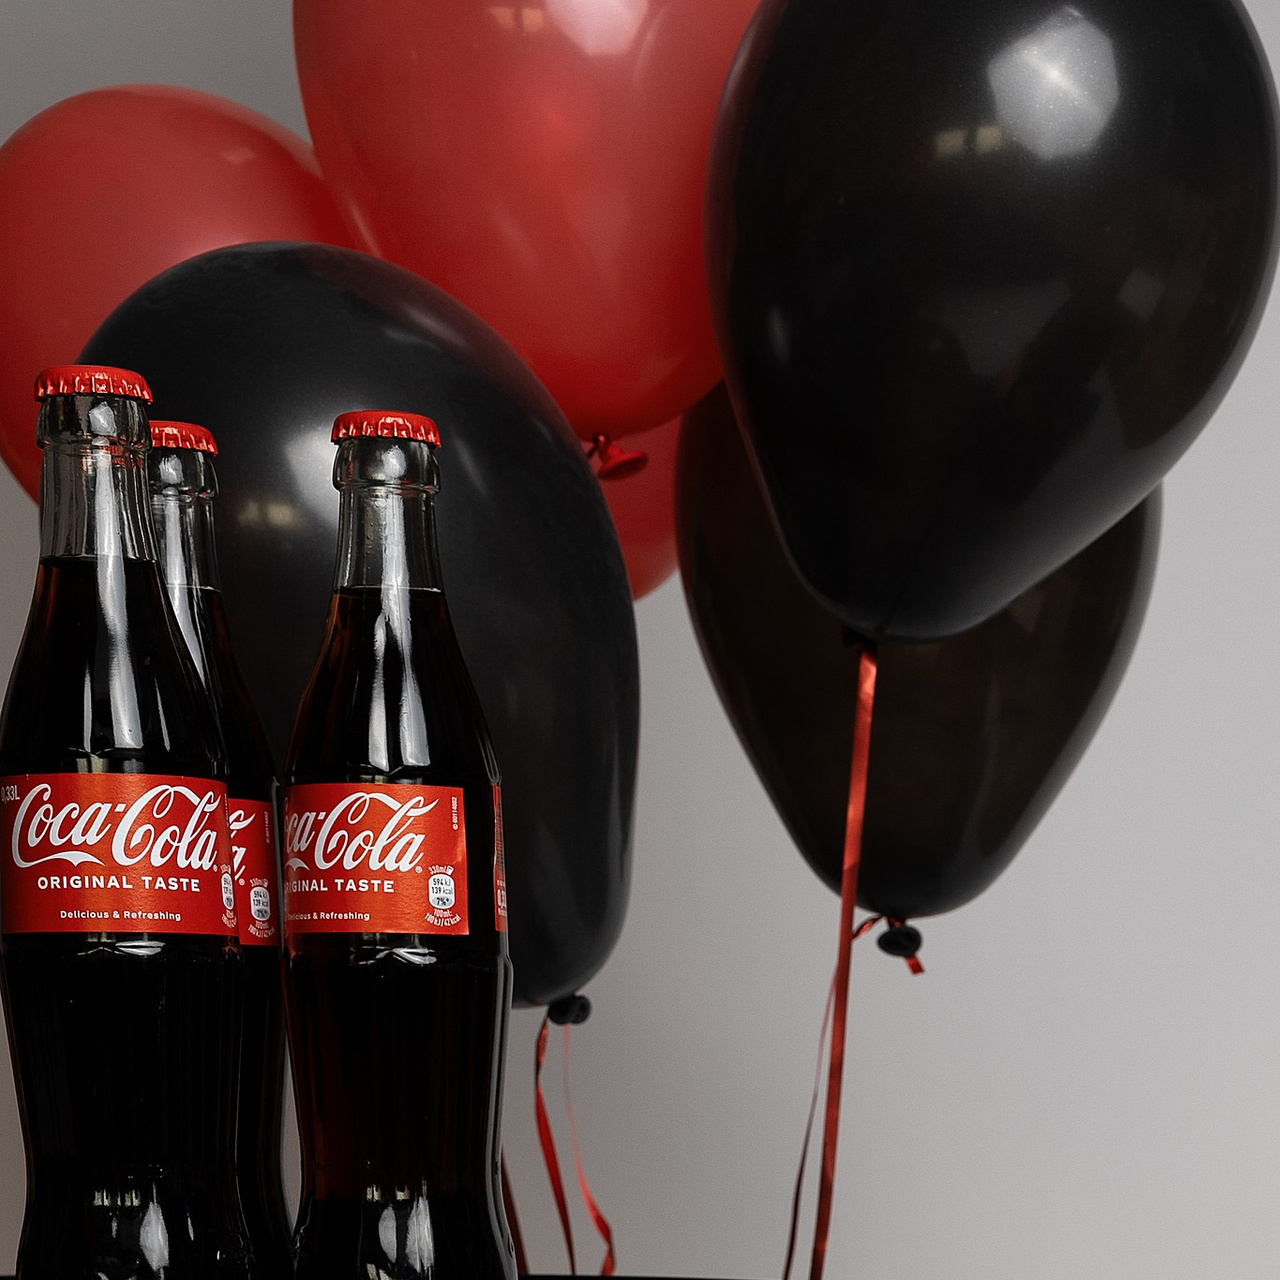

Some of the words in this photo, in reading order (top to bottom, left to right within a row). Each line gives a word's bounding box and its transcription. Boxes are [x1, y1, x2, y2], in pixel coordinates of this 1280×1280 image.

[12, 783, 221, 872] Coca-Cola
[284, 791, 439, 872] ca-Cola
[37, 875, 133, 890] ORIGINAL
[141, 876, 201, 893] TASTE
[285, 879, 328, 893] RIGINAL
[334, 879, 395, 893] TASTE
[433, 878, 443, 886] 594
[431, 887, 442, 895] 139
[60, 910, 110, 920] Delicious
[113, 911, 120, 919] &
[123, 910, 181, 922] Refreshing
[313, 912, 318, 920] &
[320, 911, 370, 921] Refreshing
